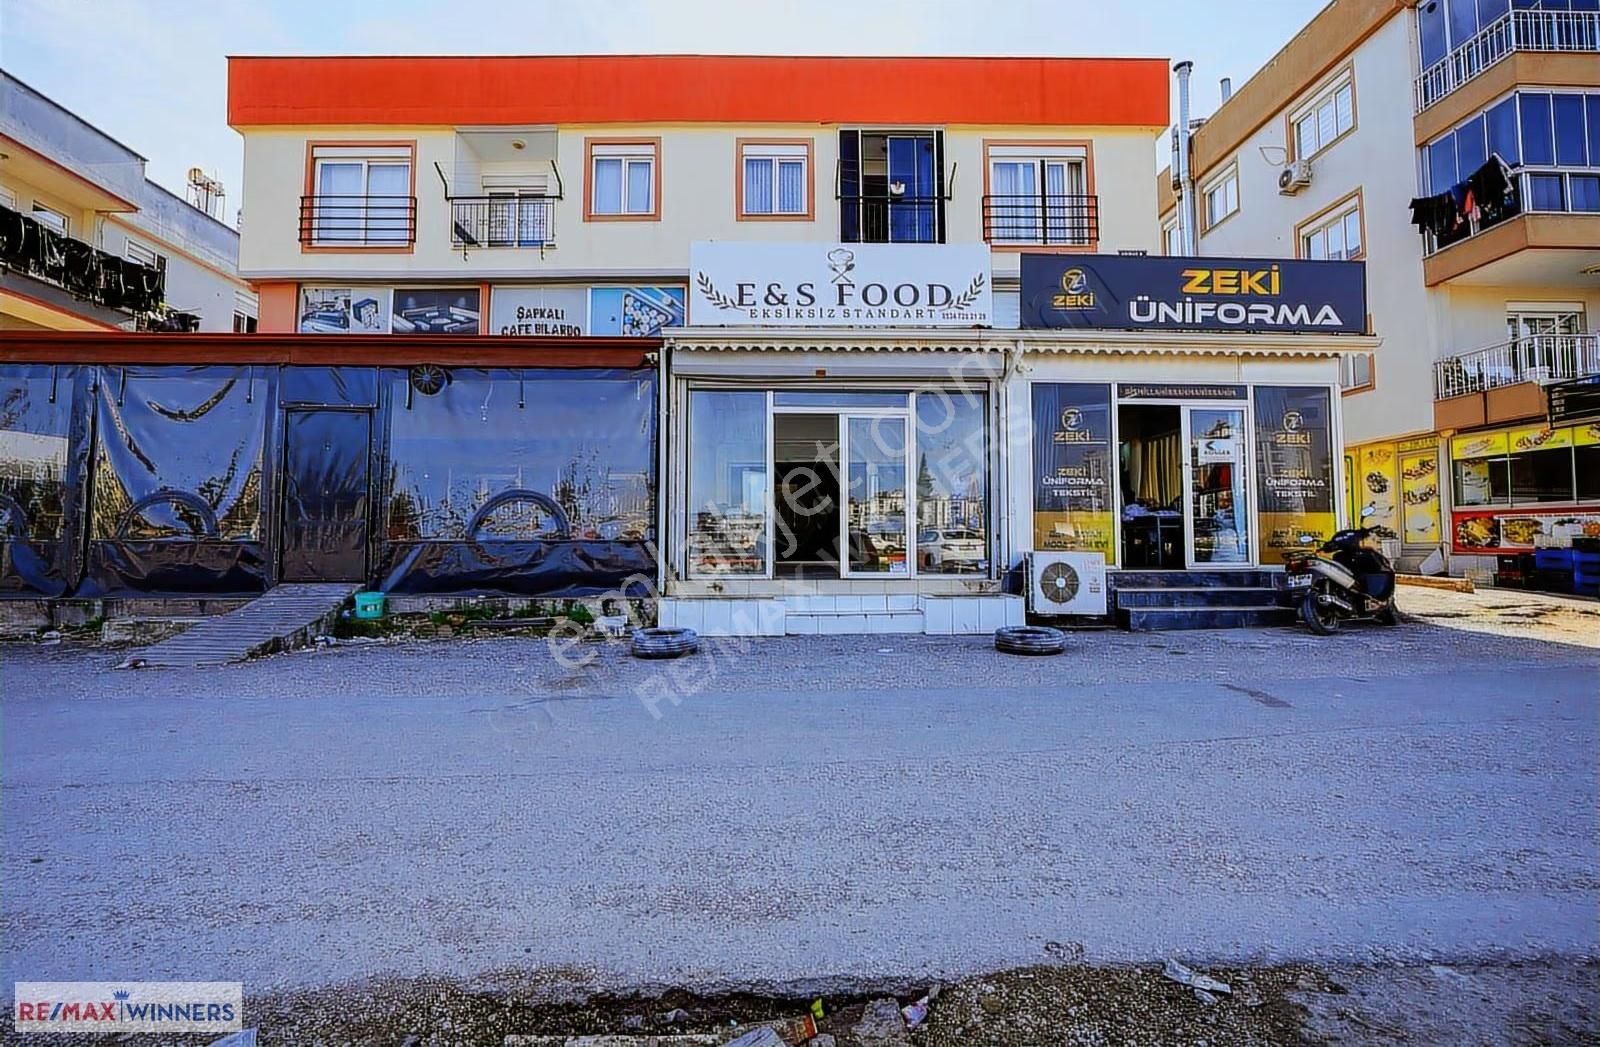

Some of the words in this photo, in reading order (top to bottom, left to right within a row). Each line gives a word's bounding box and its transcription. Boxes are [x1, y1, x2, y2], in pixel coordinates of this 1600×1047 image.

[1181, 264, 1280, 296] ZEKİ
[736, 283, 816, 307] E&S
[836, 283, 952, 307] FOOD
[1053, 292, 1094, 306] ZEKİ
[517, 306, 564, 322] ŞAPKALI
[750, 307, 836, 319] EKSİKSİZ
[843, 308, 936, 319] STANDART
[1129, 296, 1343, 326] ÜNİFORMA
[501, 323, 532, 336] CAFE
[1054, 428, 1090, 441] ZEKİ
[1276, 431, 1310, 444] ZEKİ
[1057, 466, 1087, 476] ZEKİ
[1042, 475, 1104, 485] ÜNİFORMA
[1266, 478, 1325, 487] ÜNİFORMA
[1053, 488, 1097, 497] TEKSTİL
[1275, 490, 1317, 498] TEKSTİL
